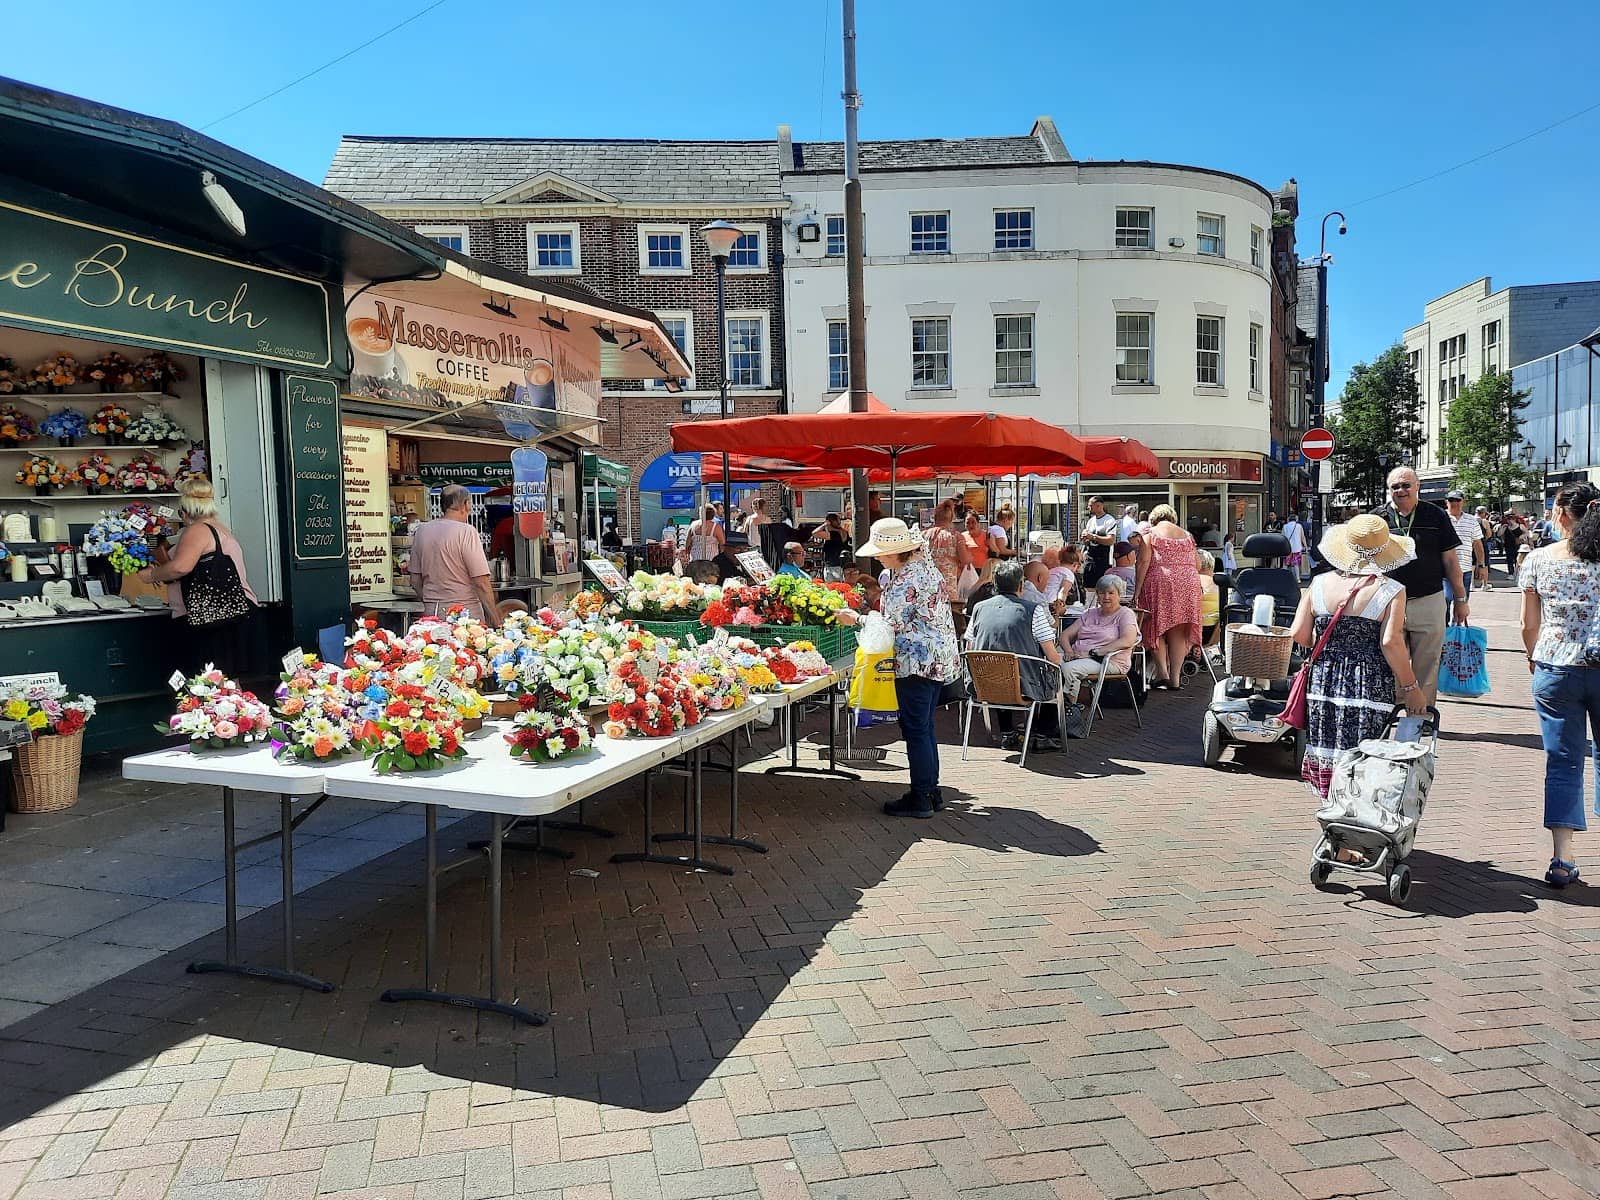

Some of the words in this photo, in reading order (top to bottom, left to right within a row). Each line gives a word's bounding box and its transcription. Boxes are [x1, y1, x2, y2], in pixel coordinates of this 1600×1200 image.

[64, 243, 267, 329] Bunch
[375, 300, 535, 370] Masserrollis
[437, 358, 490, 382] COFFEE
[416, 372, 451, 397] Freshly
[452, 381, 475, 396] made
[291, 385, 333, 405] Flowers
[305, 414, 323, 433] for
[302, 446, 327, 461] every
[296, 470, 337, 480] occasion
[431, 466, 478, 477] Winning
[1169, 460, 1227, 477] Cooplands
[513, 482, 526, 495] ICE
[527, 482, 547, 495] COLD
[307, 494, 329, 511] Tel:
[513, 496, 547, 513] SLUSH
[305, 516, 332, 528] 01302
[303, 534, 335, 546] 327107
[354, 546, 387, 558] Chocolate
[373, 573, 386, 584] Tea
[30, 677, 55, 686] unch
